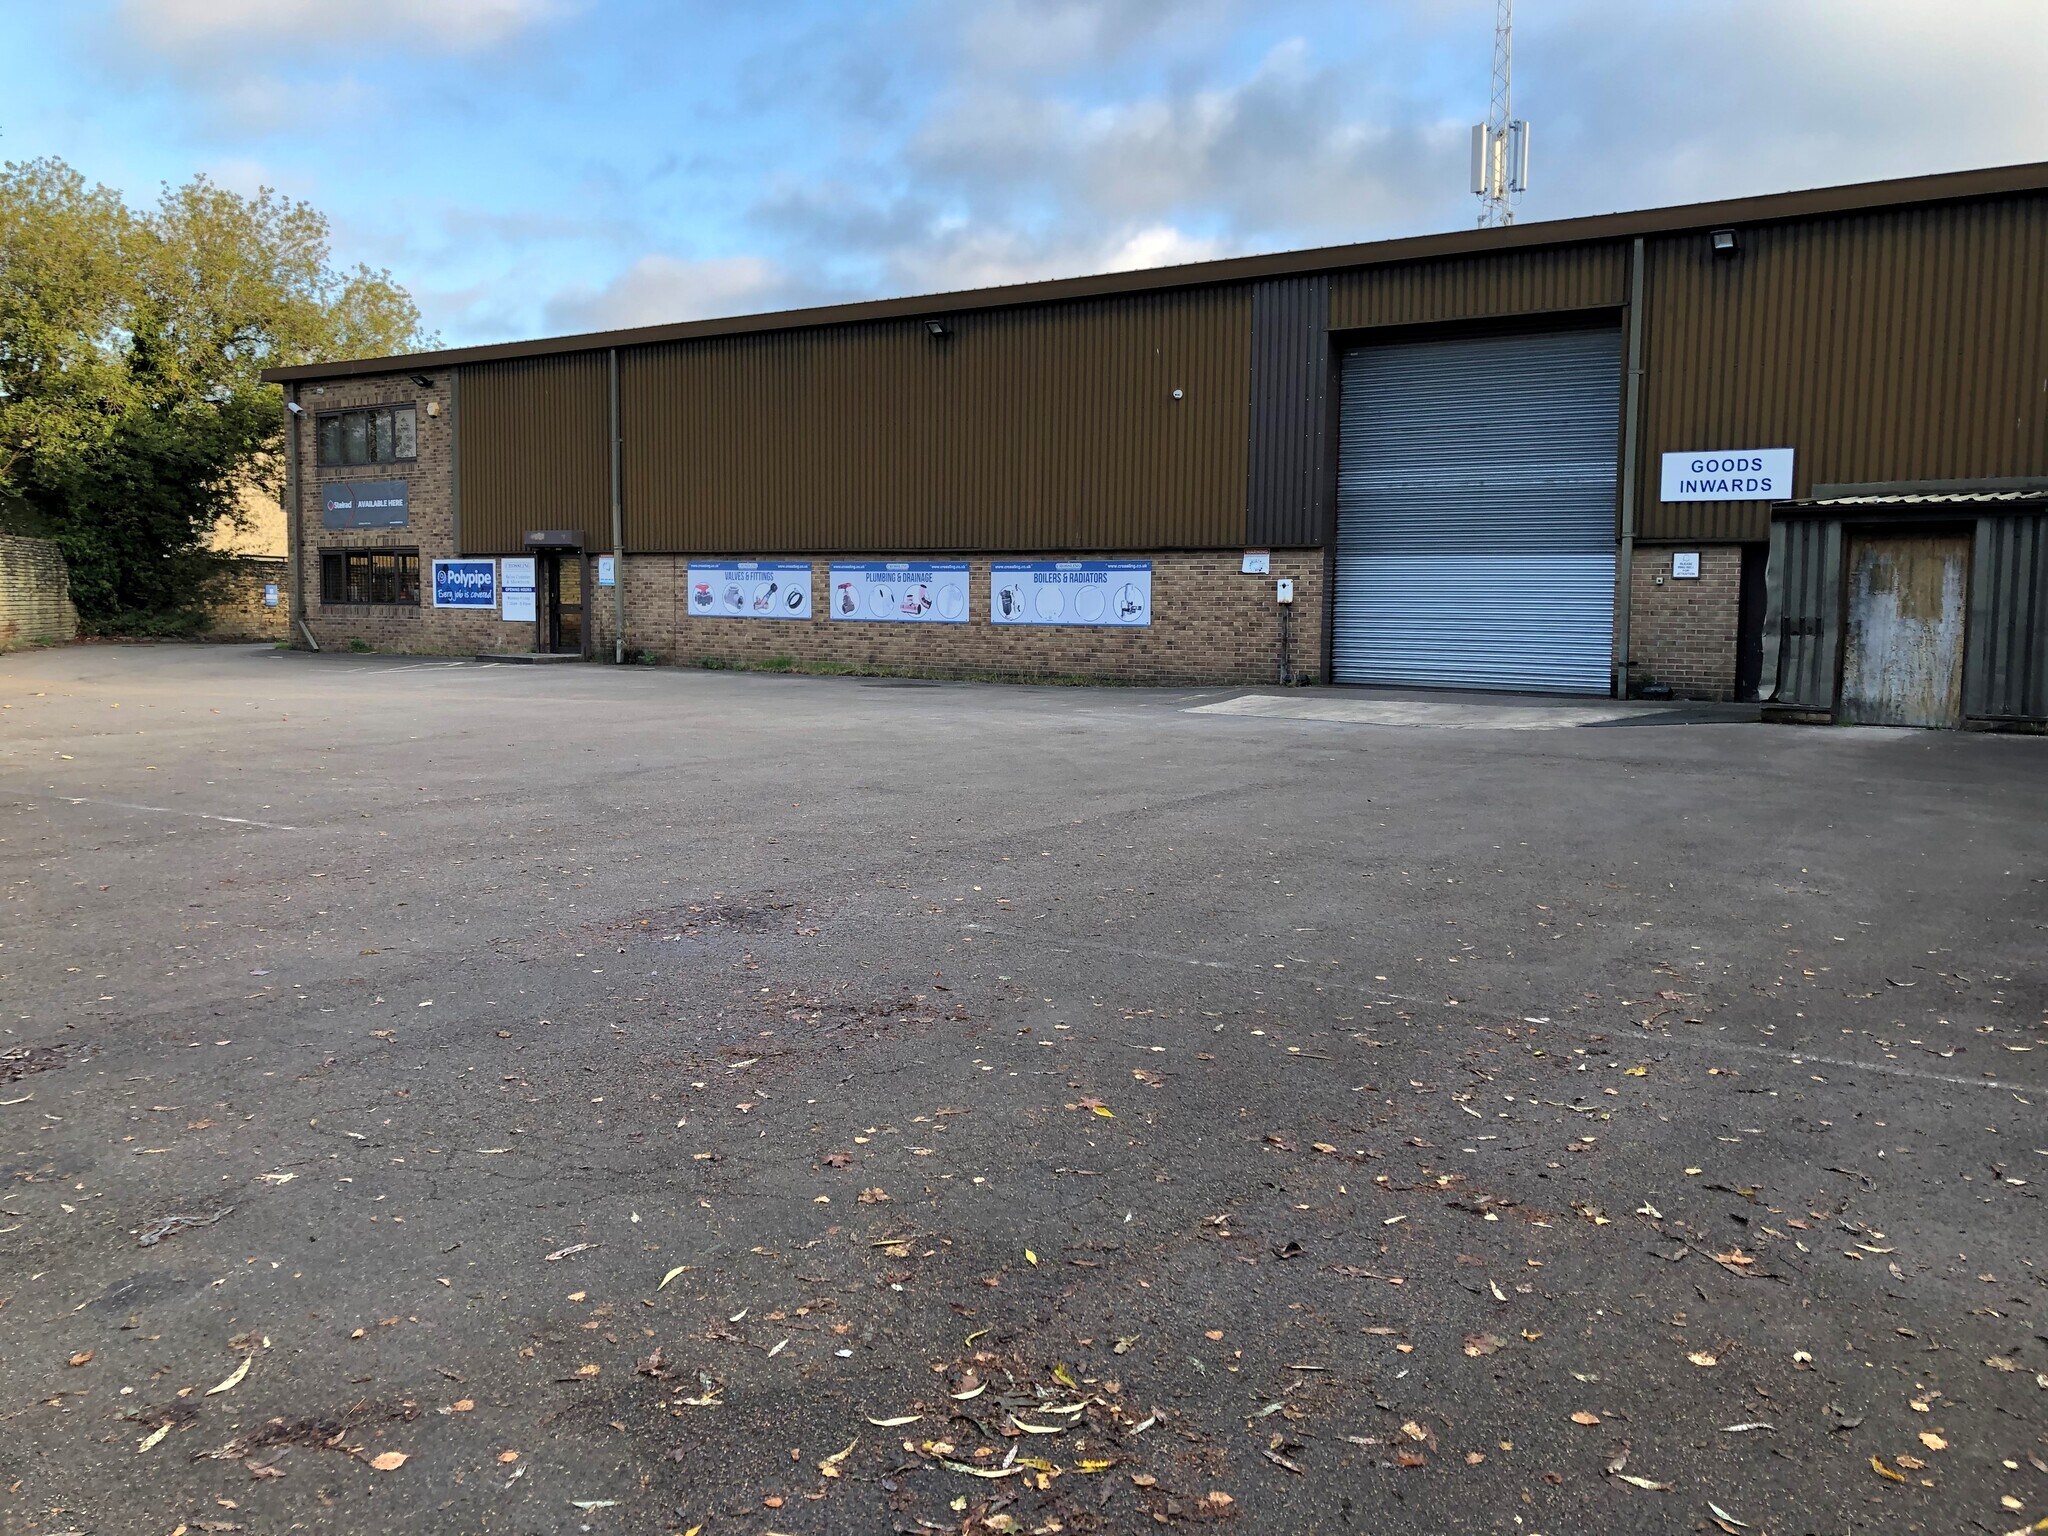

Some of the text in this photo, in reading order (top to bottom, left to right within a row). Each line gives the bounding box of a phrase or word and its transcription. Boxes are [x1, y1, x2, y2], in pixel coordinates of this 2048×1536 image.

[1691, 458, 1763, 473] GOODS
[1680, 478, 1772, 493] INWARDS
[333, 499, 403, 509] Stelrad AVAILABLE HERE
[447, 569, 492, 588] Polypipe
[724, 572, 774, 581] VALVES & FITTINGS
[865, 573, 933, 583] PLUMBING & DRAINAGE
[1033, 572, 1108, 584] BOILERS & RADIATORS
[437, 589, 492, 602] Every job is covered
